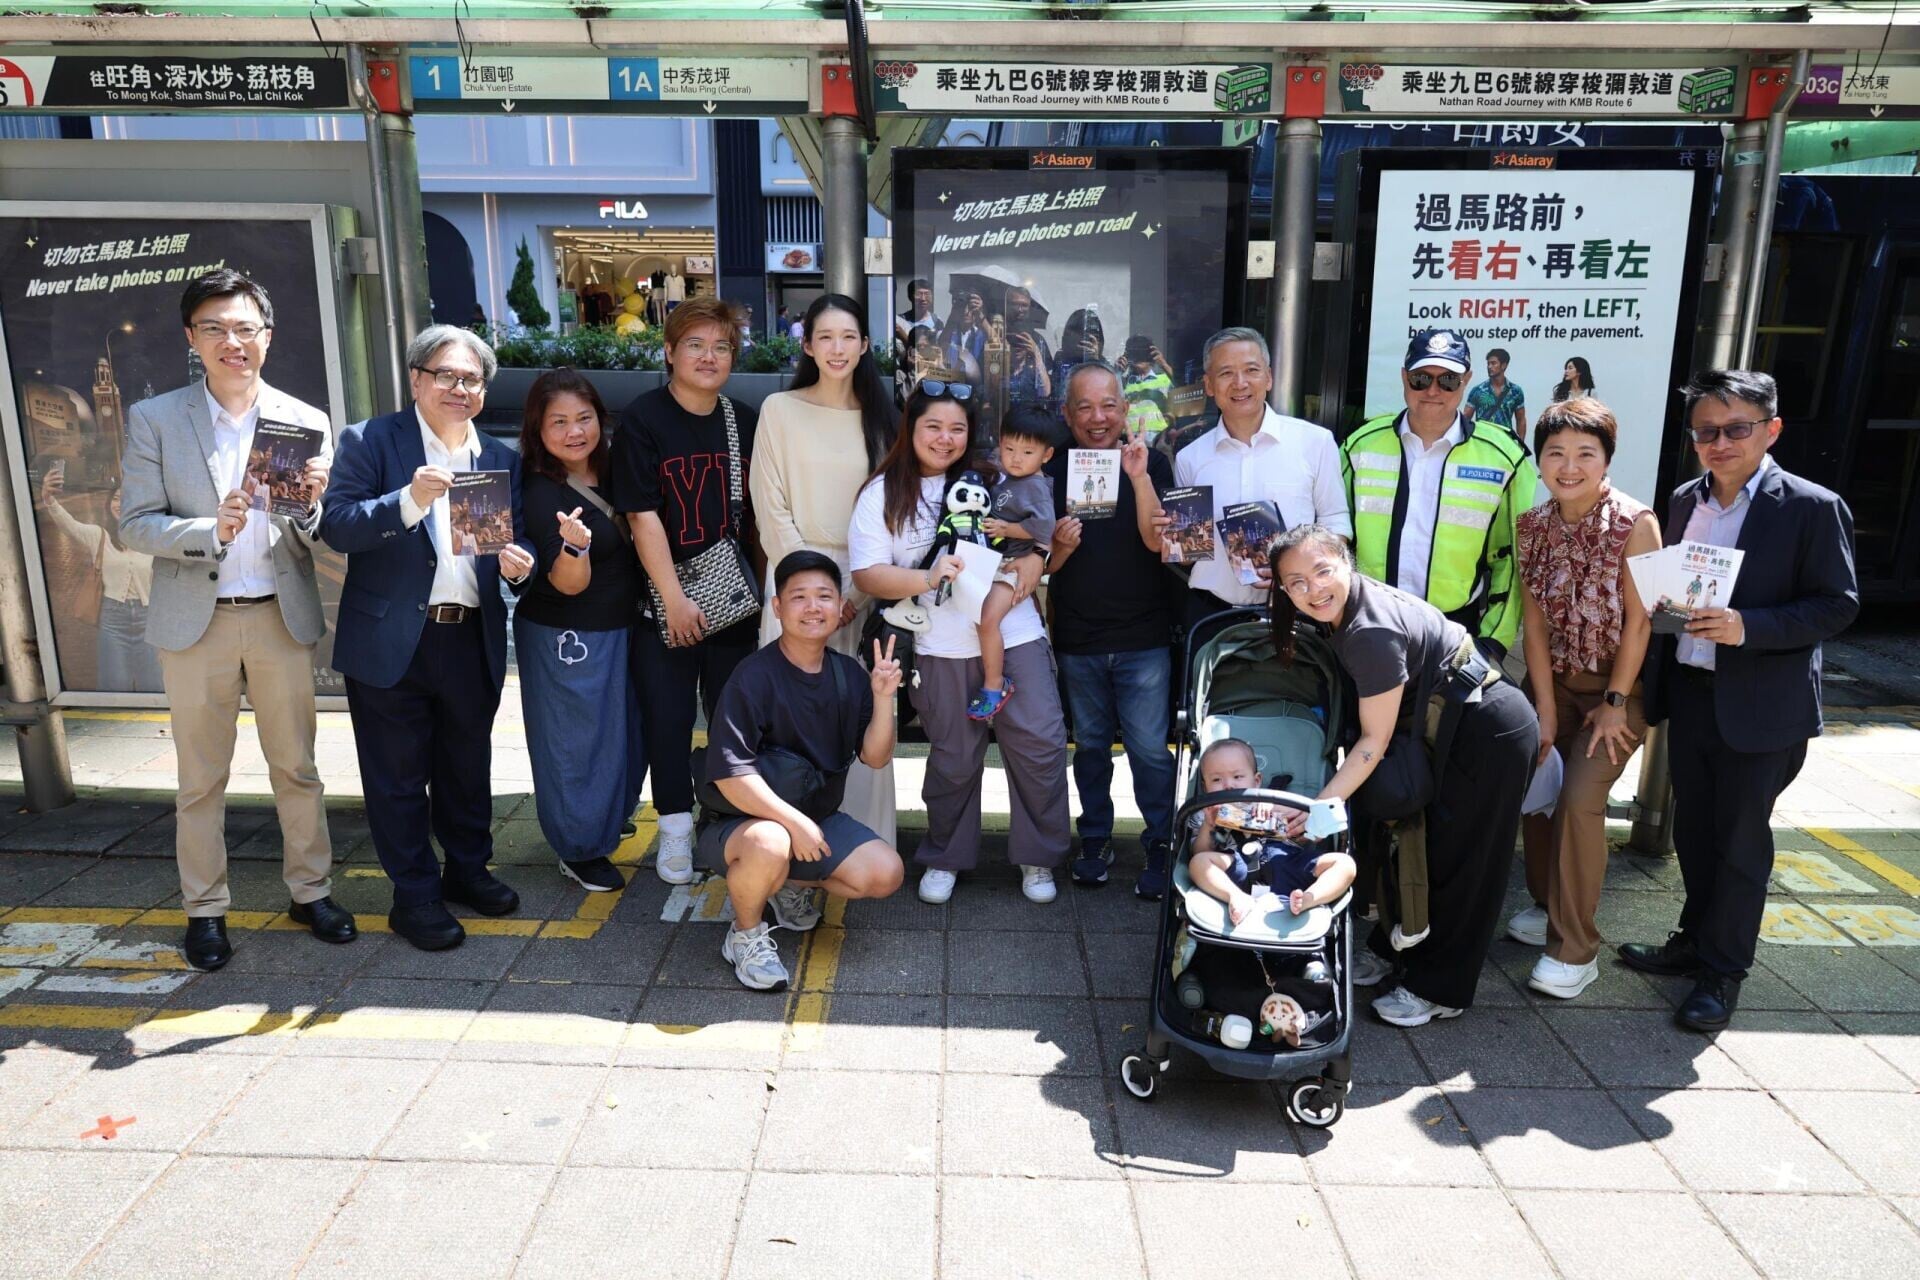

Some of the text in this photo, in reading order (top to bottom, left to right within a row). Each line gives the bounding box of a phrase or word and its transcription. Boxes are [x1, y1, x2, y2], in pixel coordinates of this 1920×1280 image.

[90, 64, 316, 90] 往旺角、深水埗、荔枝角
[428, 65, 441, 90] 1
[464, 66, 514, 84] 竹園邨
[618, 66, 653, 92] 1A
[663, 67, 731, 85] 中秀茂坪
[936, 68, 1208, 93] 乘坐九巴6號線穿梭彌敦道
[1402, 71, 1674, 96] 乘坐九巴6號線穿梭彌敦道
[1844, 75, 1890, 90] 大坑東
[464, 84, 532, 93] Chuk Yuen Estate
[663, 85, 752, 96] Sau Mau Ping (Central)
[1802, 76, 1840, 94] 03C
[106, 90, 304, 102] To Mong Kok, Sham Shui Po, Lai Chi Kok
[975, 95, 1169, 106] Nathan Road Journey with KMB Route 6
[1439, 98, 1632, 109] Nathan Road Journey with KMB Route 6
[1048, 154, 1094, 168] Asiaray
[1508, 154, 1554, 167] Asiaray
[599, 200, 648, 218] FILA
[953, 186, 1106, 222] 切勿在馬路上拍照
[1414, 193, 1584, 232] 過馬路前，
[930, 211, 1138, 254] Never take photos on road
[43, 233, 190, 267] 切勿在馬路上拍照
[1412, 239, 1651, 280] 先看右、再看左
[26, 278, 72, 298] Never
[74, 272, 108, 293] take
[109, 268, 162, 293] photos
[165, 266, 184, 283] on
[1408, 298, 1640, 322] Look RIGHT, then LEFT,
[1488, 327, 1518, 342] step
[1521, 326, 1541, 339] off
[1544, 326, 1566, 339] the
[1570, 326, 1644, 342] pavement.
